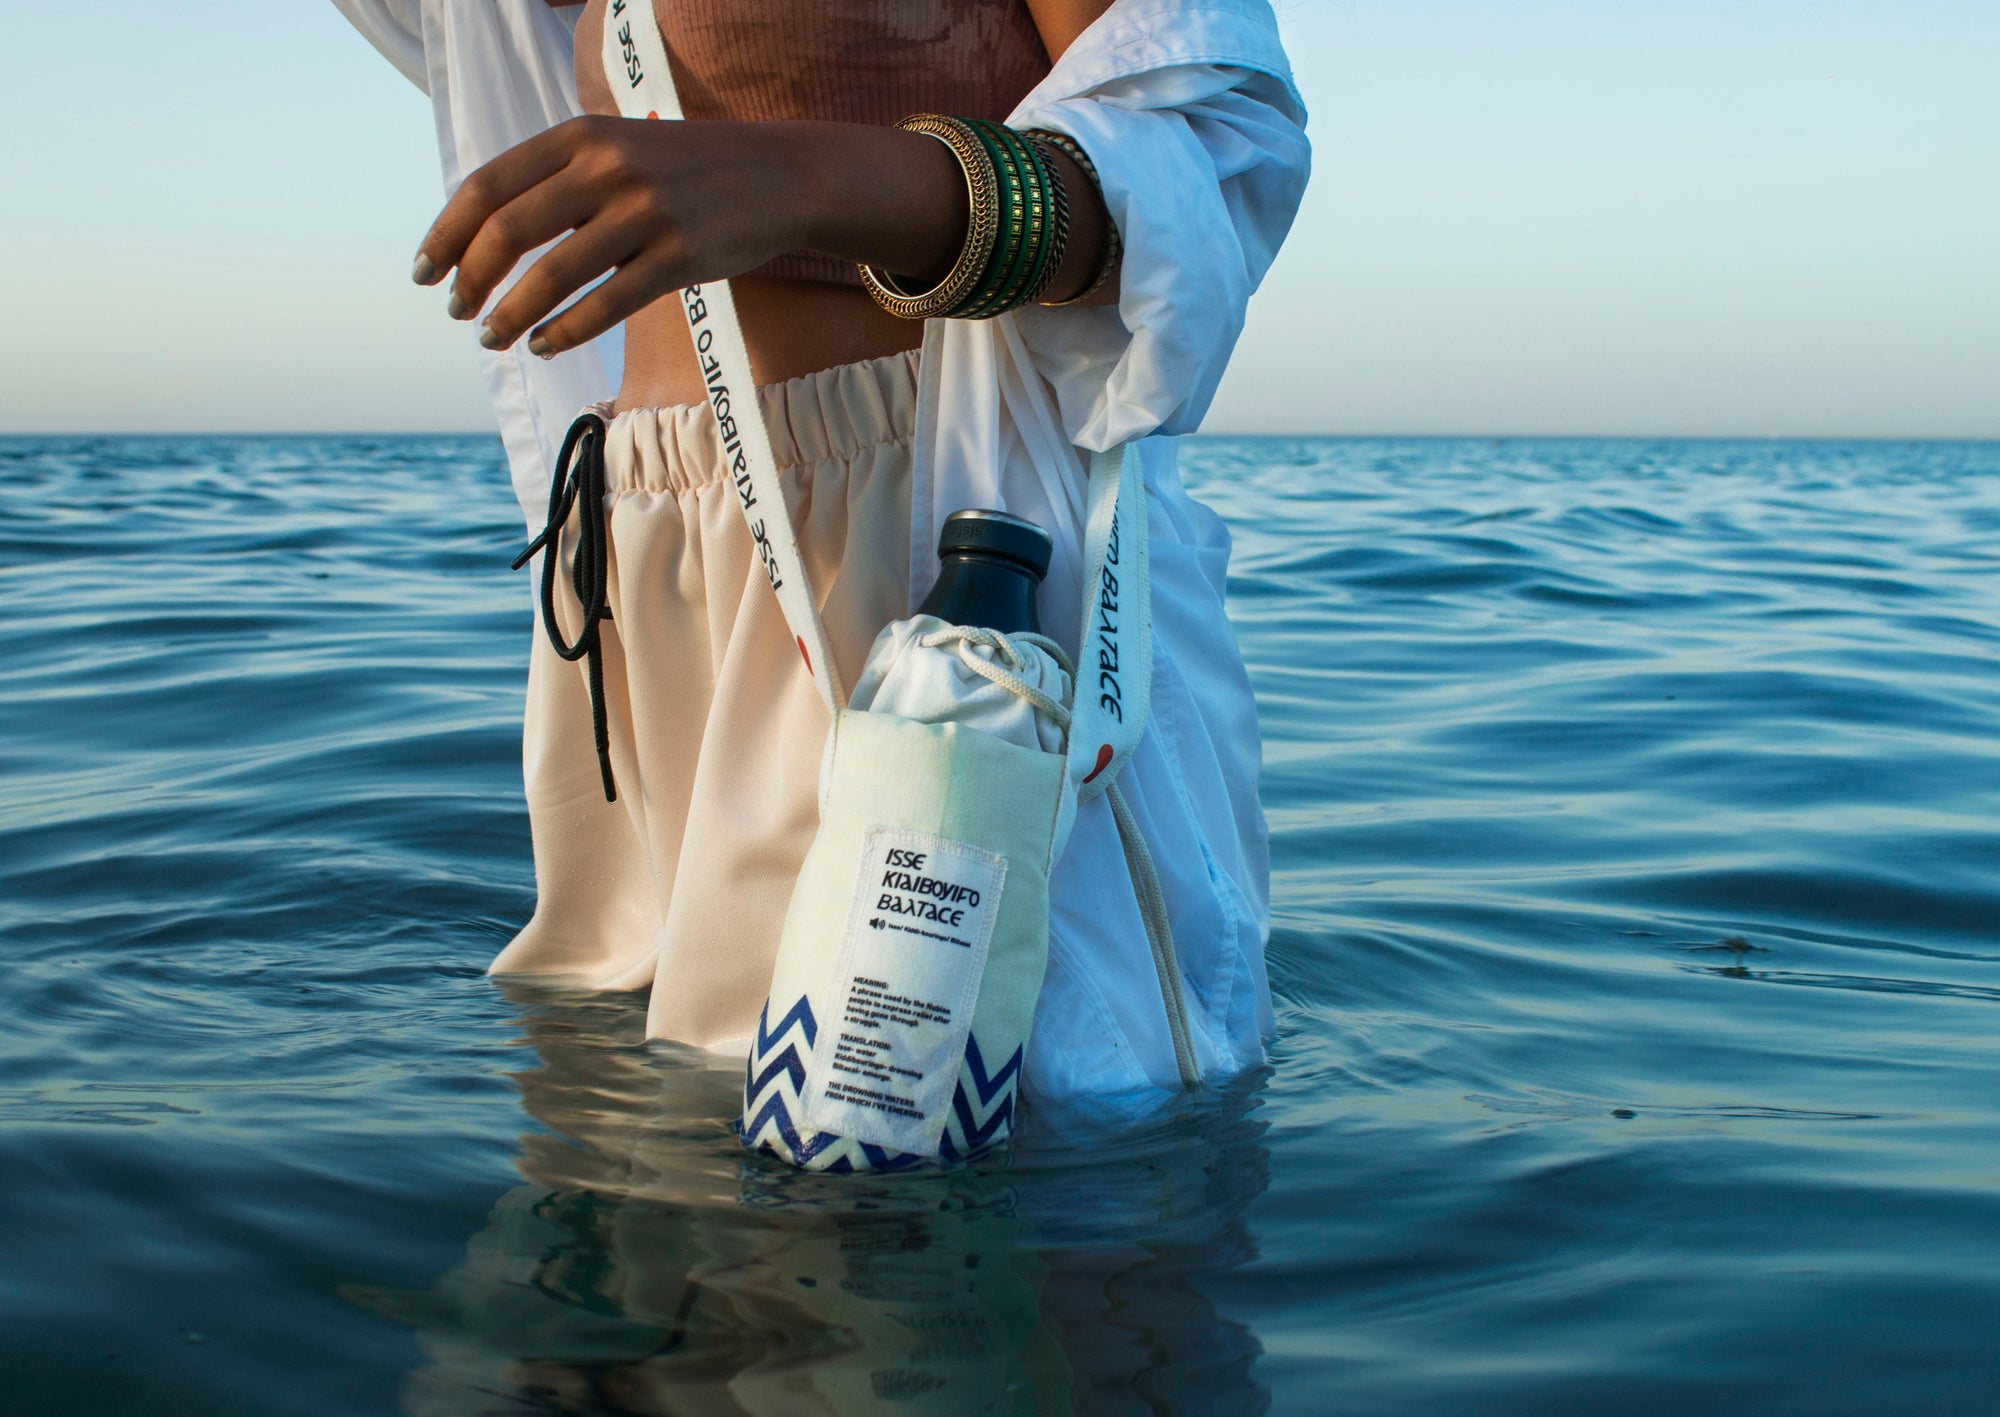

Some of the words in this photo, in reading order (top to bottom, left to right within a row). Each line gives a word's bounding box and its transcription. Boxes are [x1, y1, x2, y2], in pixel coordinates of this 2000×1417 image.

[618, 20, 644, 89] ISSE
[750, 518, 784, 592] ISSE
[885, 848, 927, 871] ISSE
[853, 976, 890, 990] MEANING:
[848, 996, 872, 1007] people
[873, 1000, 881, 1008] to
[882, 1003, 911, 1016] express
[912, 1009, 933, 1019] relief
[933, 1014, 951, 1024] after
[857, 988, 882, 999] phrase
[883, 993, 902, 1002] used
[903, 997, 912, 1006] by
[913, 999, 925, 1008] the
[926, 1002, 951, 1015] Nubian
[846, 1005, 870, 1017] having
[870, 1011, 889, 1020] gone
[890, 1014, 919, 1027] through
[850, 1016, 882, 1029] struggle.
[840, 1033, 893, 1051] TRANSLATION:
[855, 1048, 877, 1058] water
[862, 1070, 892, 1082] emerge.
[888, 1065, 924, 1080] drowning
[824, 1090, 845, 1101] FROM
[846, 1096, 871, 1108] WHICH
[872, 1102, 887, 1111] I'VE
[828, 1081, 842, 1090] THE
[843, 1085, 883, 1100] DROWNING
[884, 1094, 915, 1107] WATERS
